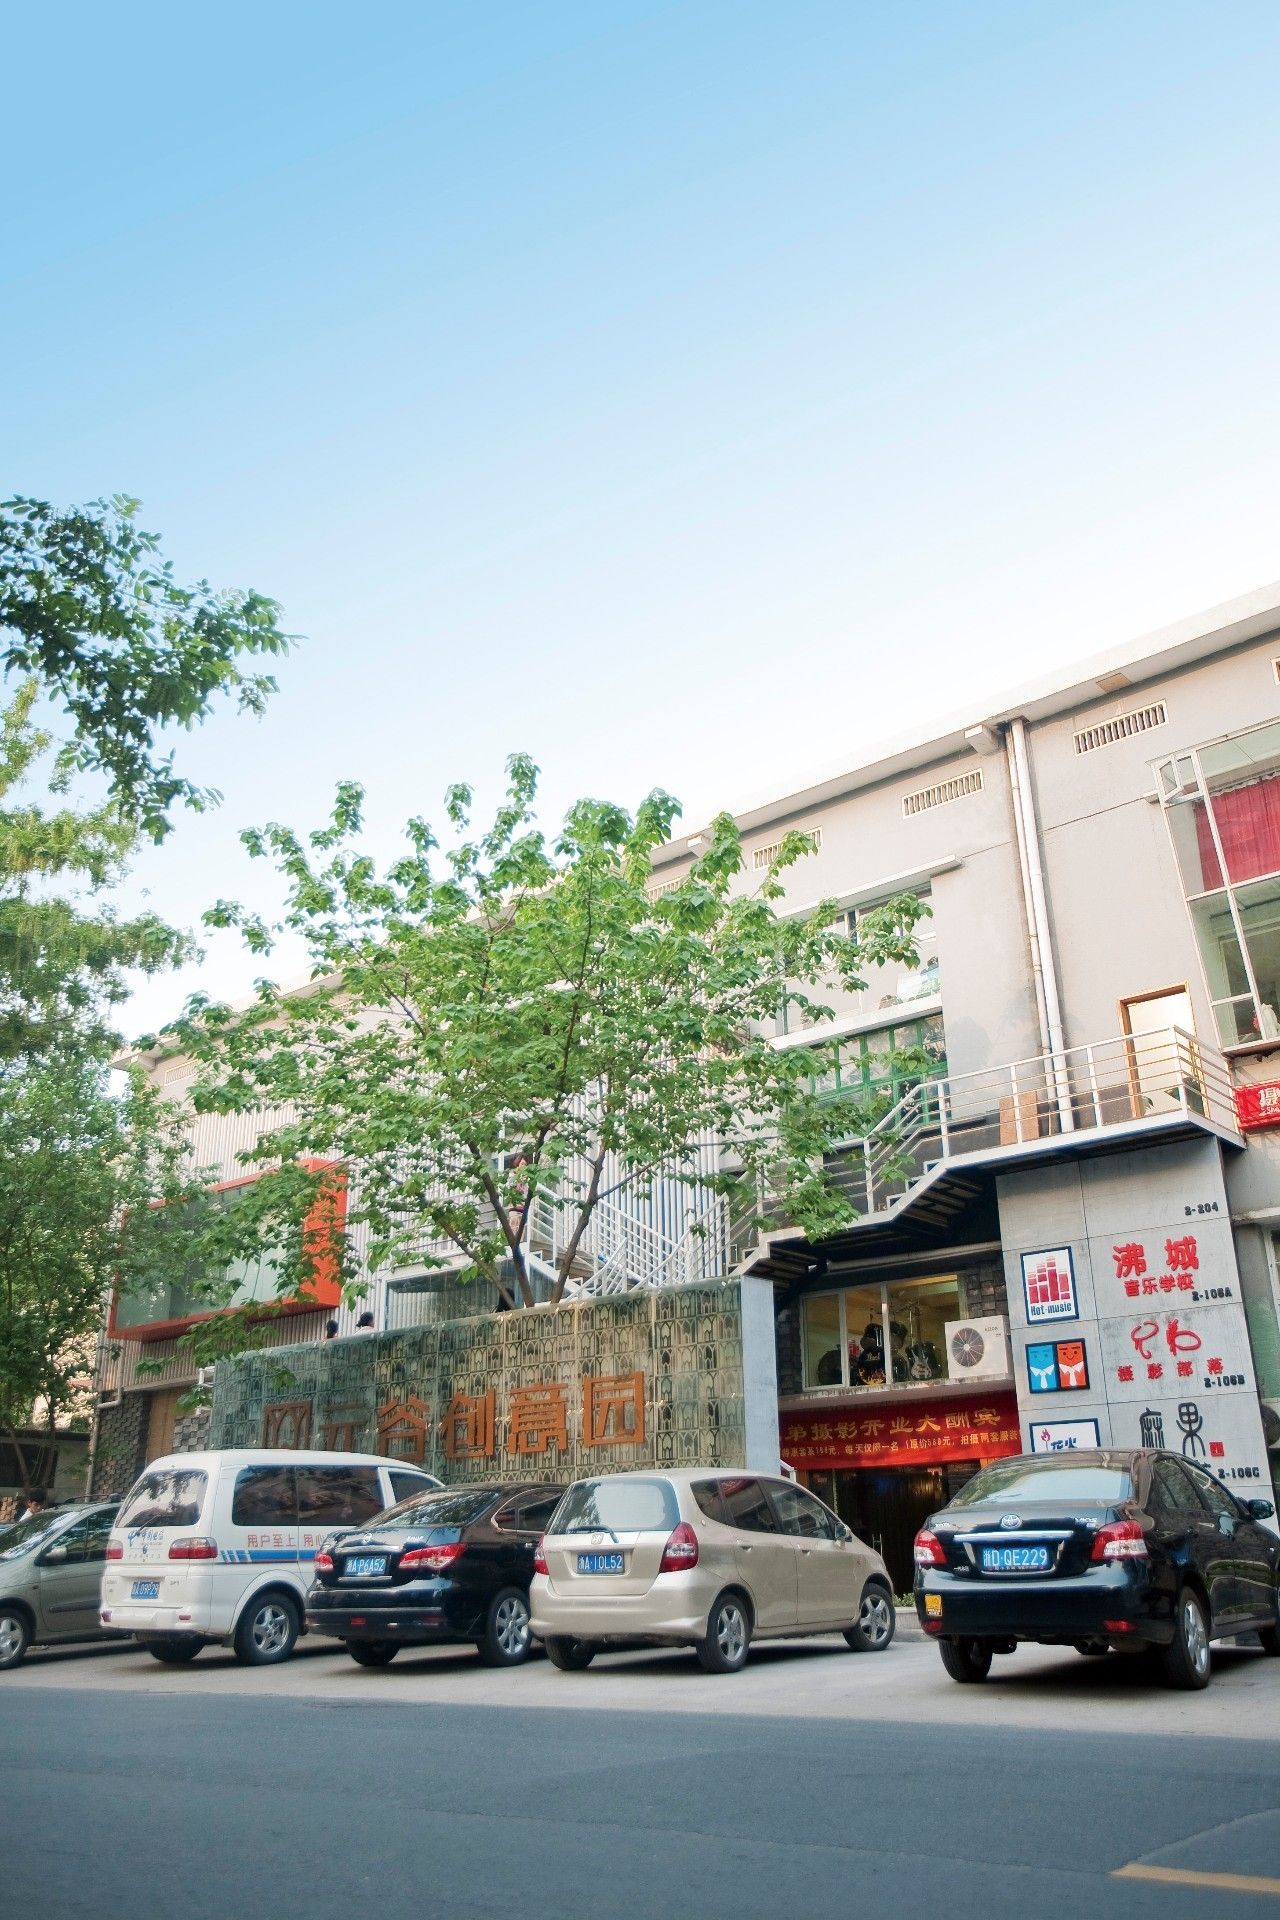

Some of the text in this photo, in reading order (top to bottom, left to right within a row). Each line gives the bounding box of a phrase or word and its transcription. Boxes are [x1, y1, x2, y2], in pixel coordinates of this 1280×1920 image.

[1185, 1202, 1219, 1216] 2-204
[1124, 1272, 1195, 1298] 音乐学校
[247, 1533, 297, 1548] 用户至上
